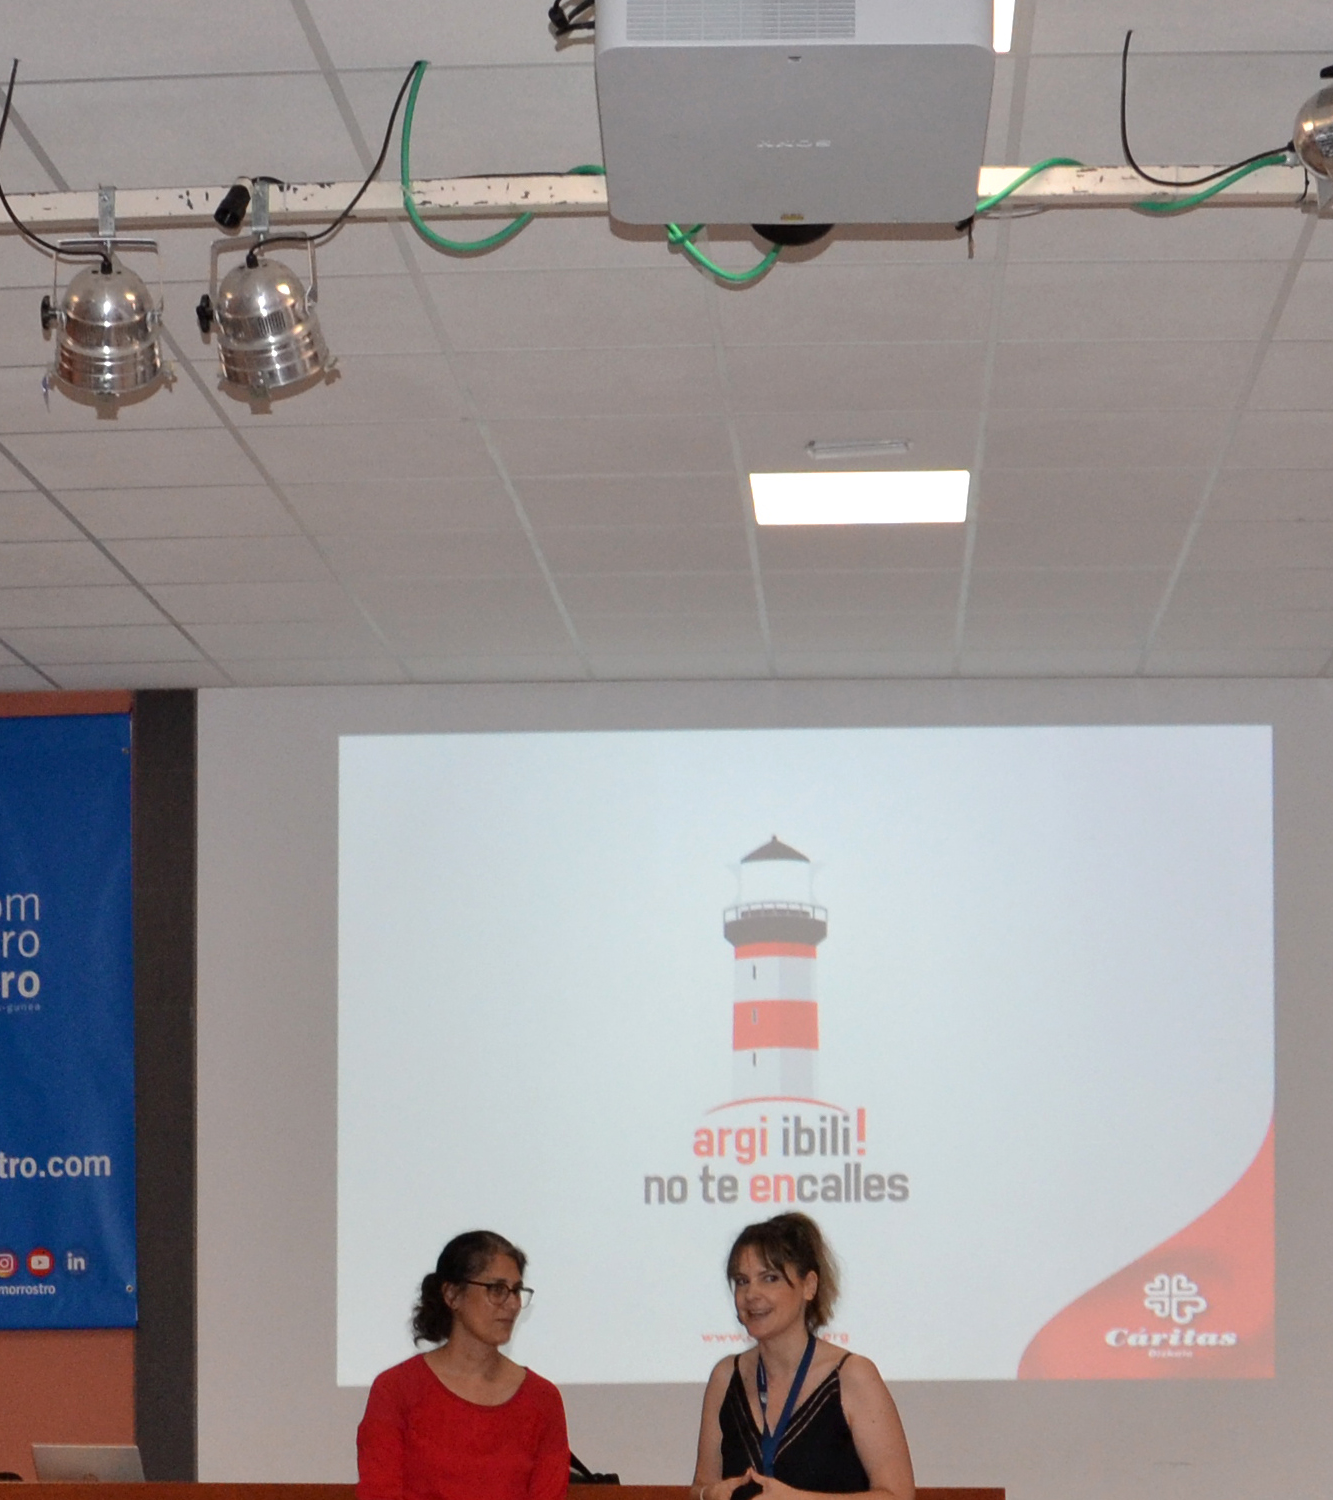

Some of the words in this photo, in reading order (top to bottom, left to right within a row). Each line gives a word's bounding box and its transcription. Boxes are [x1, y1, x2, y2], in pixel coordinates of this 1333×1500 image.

[693, 1116, 768, 1165] argi
[782, 1107, 866, 1157] ibili!
[644, 1174, 689, 1205] no
[699, 1164, 740, 1205] te
[749, 1162, 910, 1204] encalles
[1105, 1327, 1238, 1347] Cáritas
